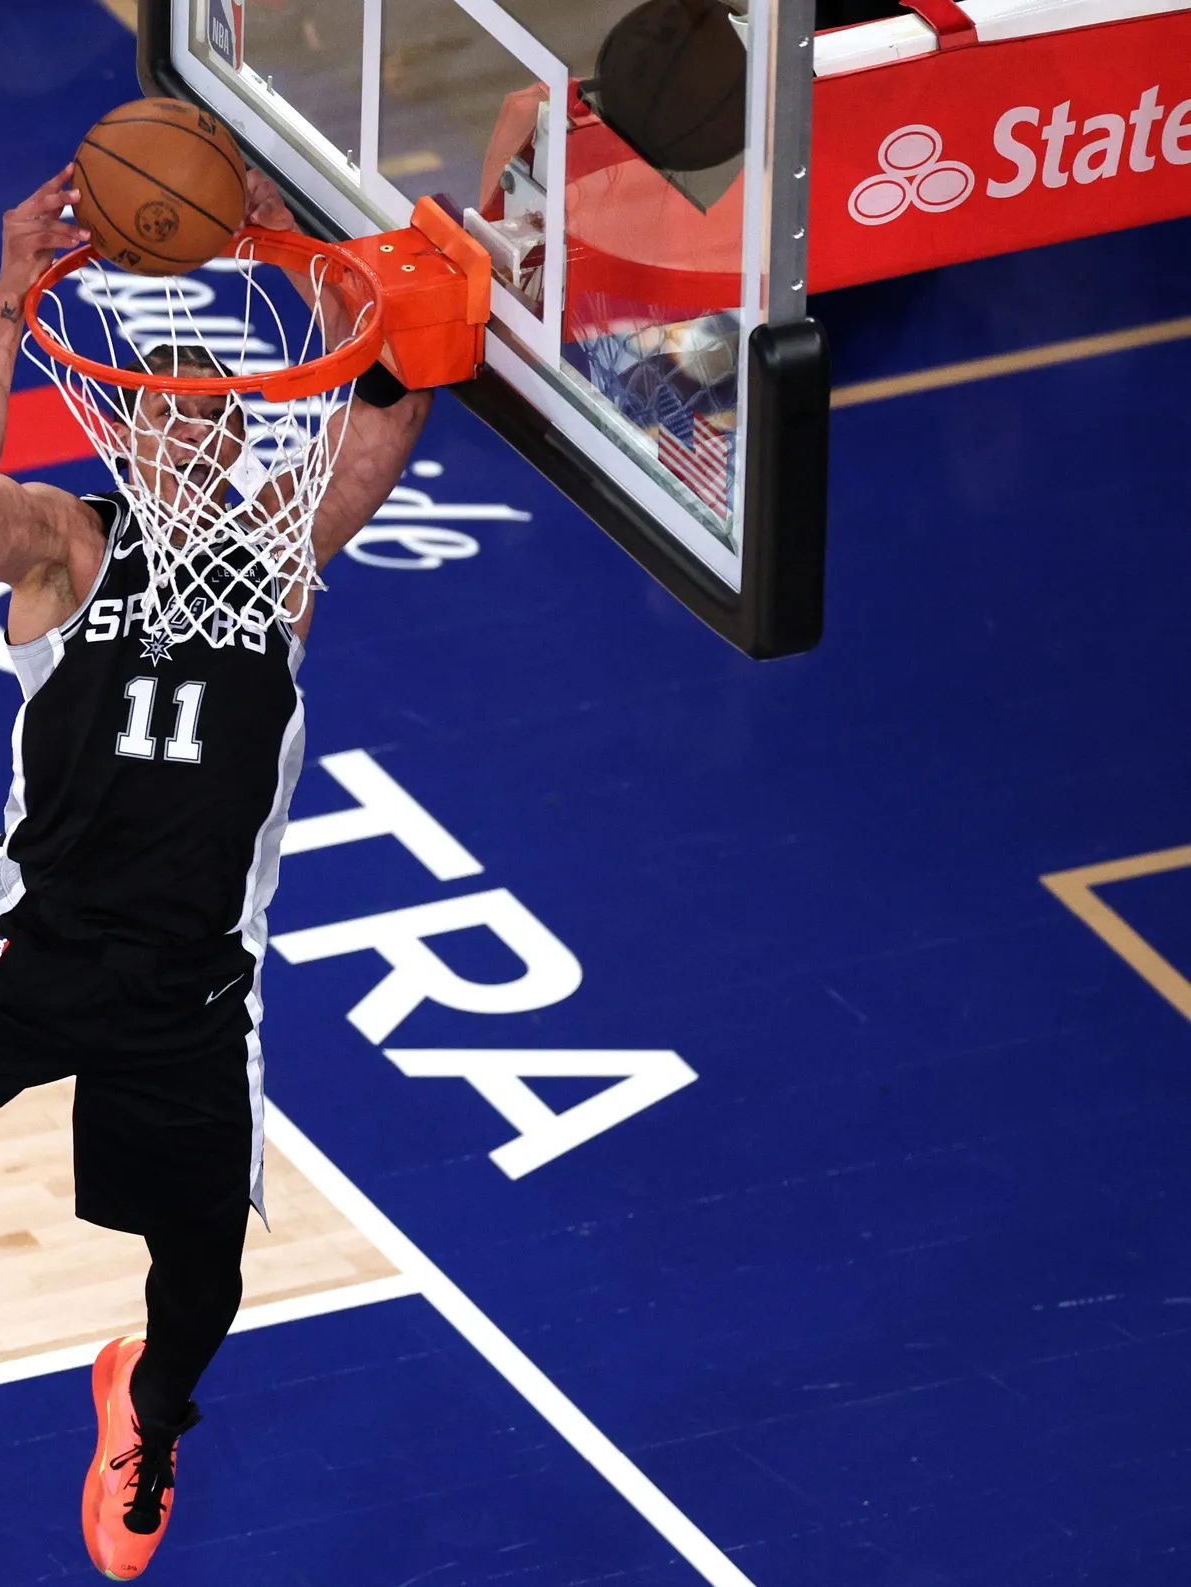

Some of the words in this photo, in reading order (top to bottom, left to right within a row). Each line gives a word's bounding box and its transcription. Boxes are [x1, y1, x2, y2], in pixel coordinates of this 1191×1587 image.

[212, 17, 230, 55] NBA
[986, 84, 1191, 199] State
[115, 676, 207, 764] 11
